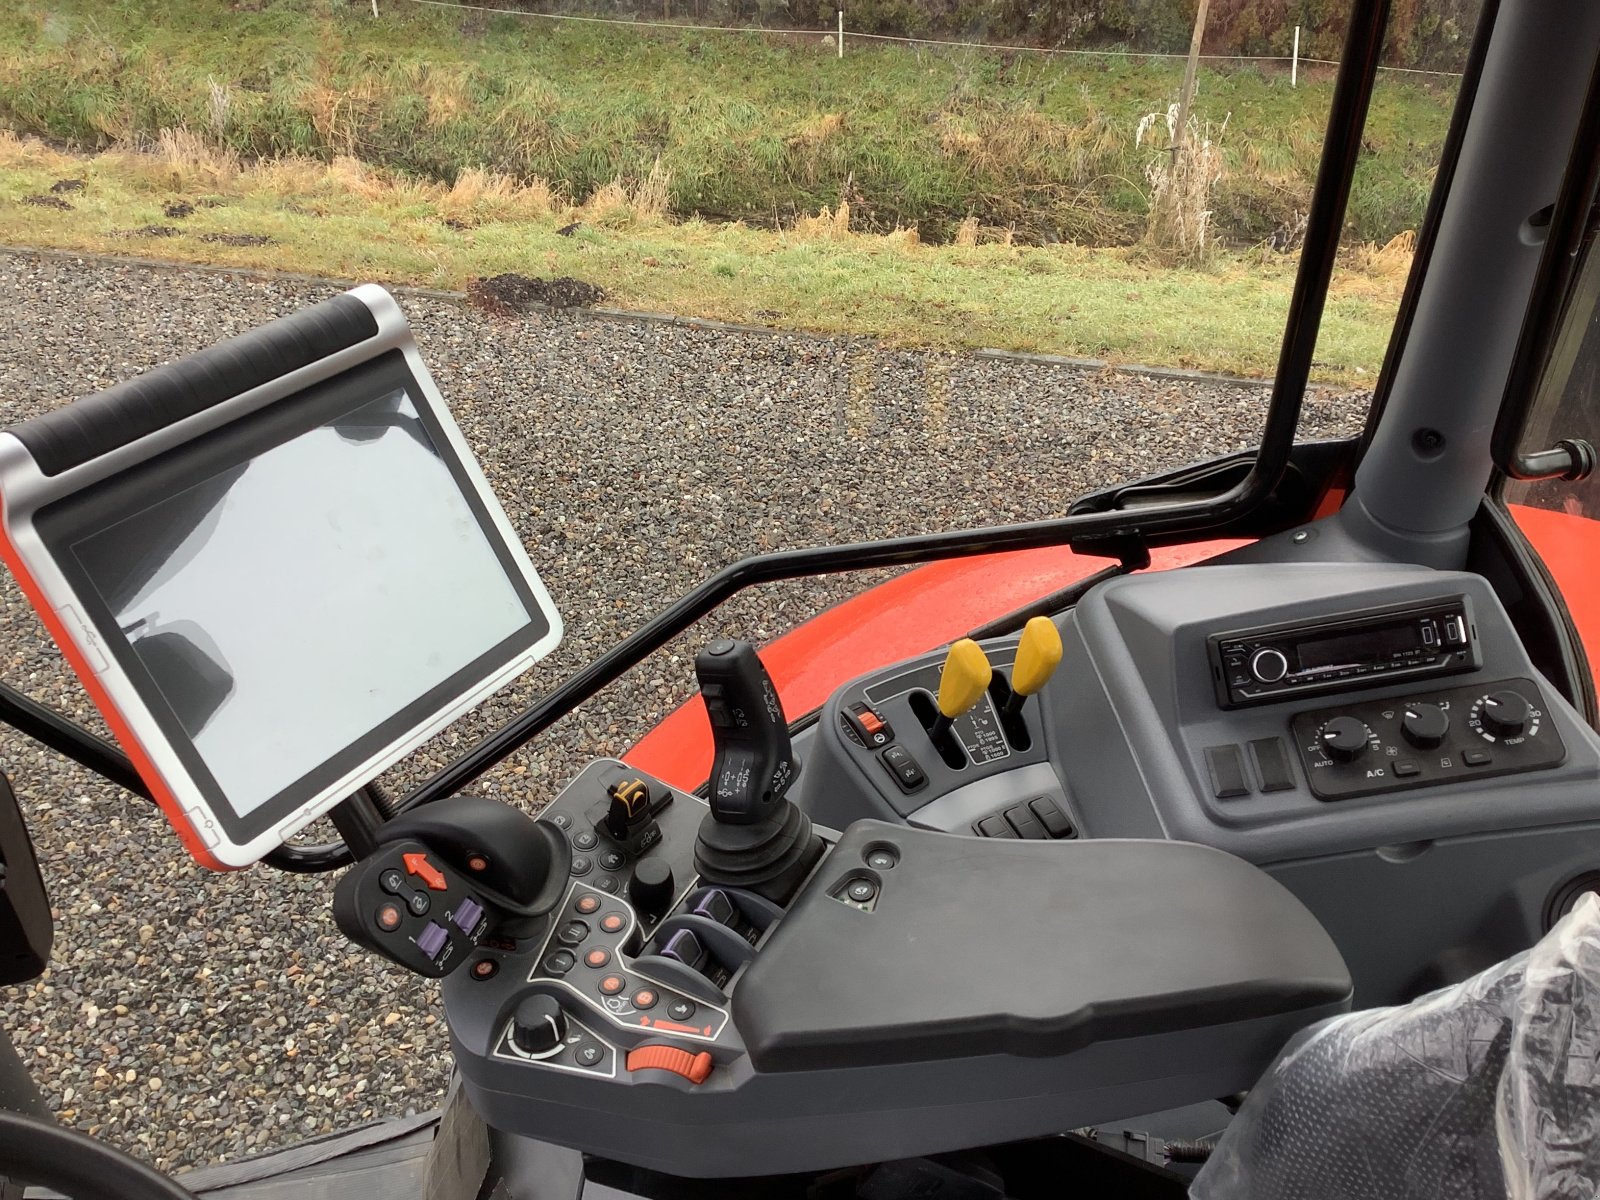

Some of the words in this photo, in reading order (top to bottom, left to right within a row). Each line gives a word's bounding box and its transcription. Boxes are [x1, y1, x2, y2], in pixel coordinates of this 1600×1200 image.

[1469, 719, 1482, 727] 20
[1504, 737, 1525, 746] TEMP
[1314, 760, 1334, 768] AUTO
[1366, 768, 1385, 778] A/C
[445, 910, 454, 922] 2
[408, 936, 416, 944] 1
